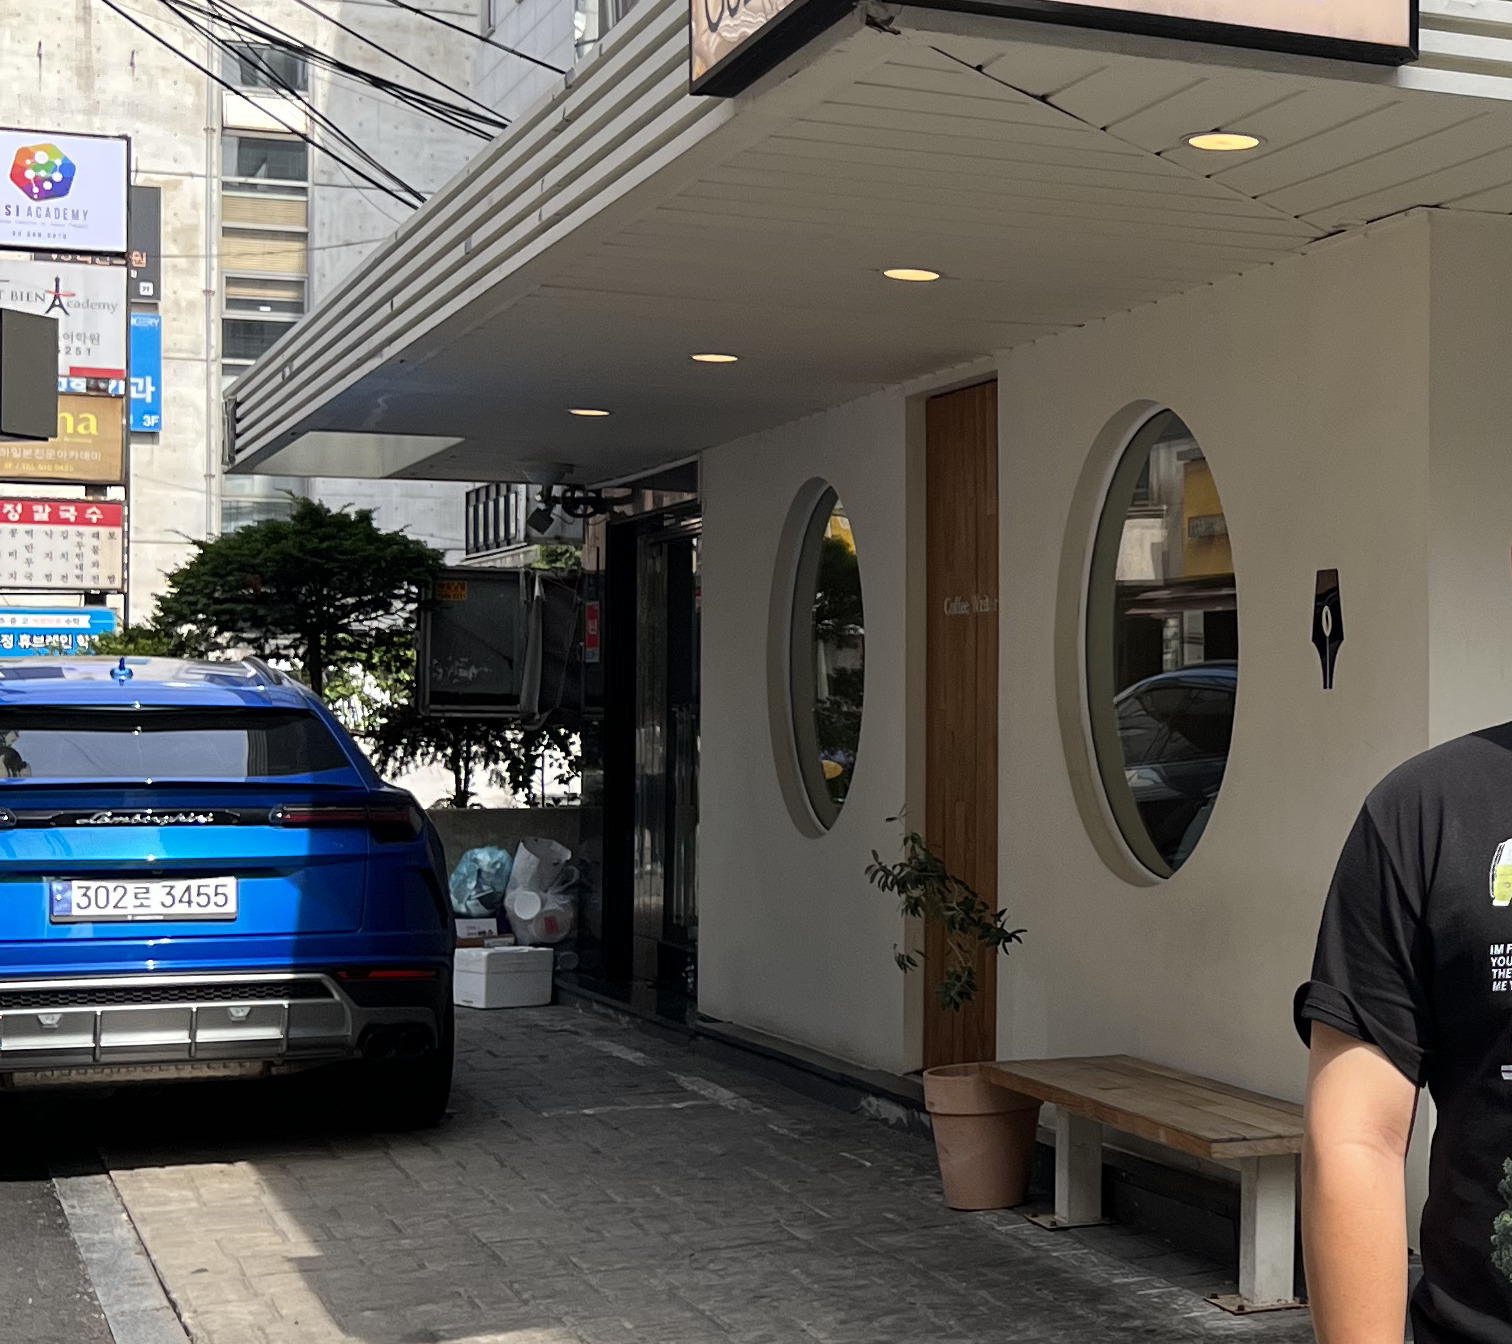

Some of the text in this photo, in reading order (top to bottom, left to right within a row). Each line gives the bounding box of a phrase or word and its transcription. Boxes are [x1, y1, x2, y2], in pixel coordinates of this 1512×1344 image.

[26, 205, 89, 221] ACADEMY
[10, 290, 46, 303] BIEN
[142, 413, 160, 427] 3F
[76, 884, 229, 910] 302로 3455
[1489, 944, 1504, 955] IM
[1492, 980, 1507, 992] ME
